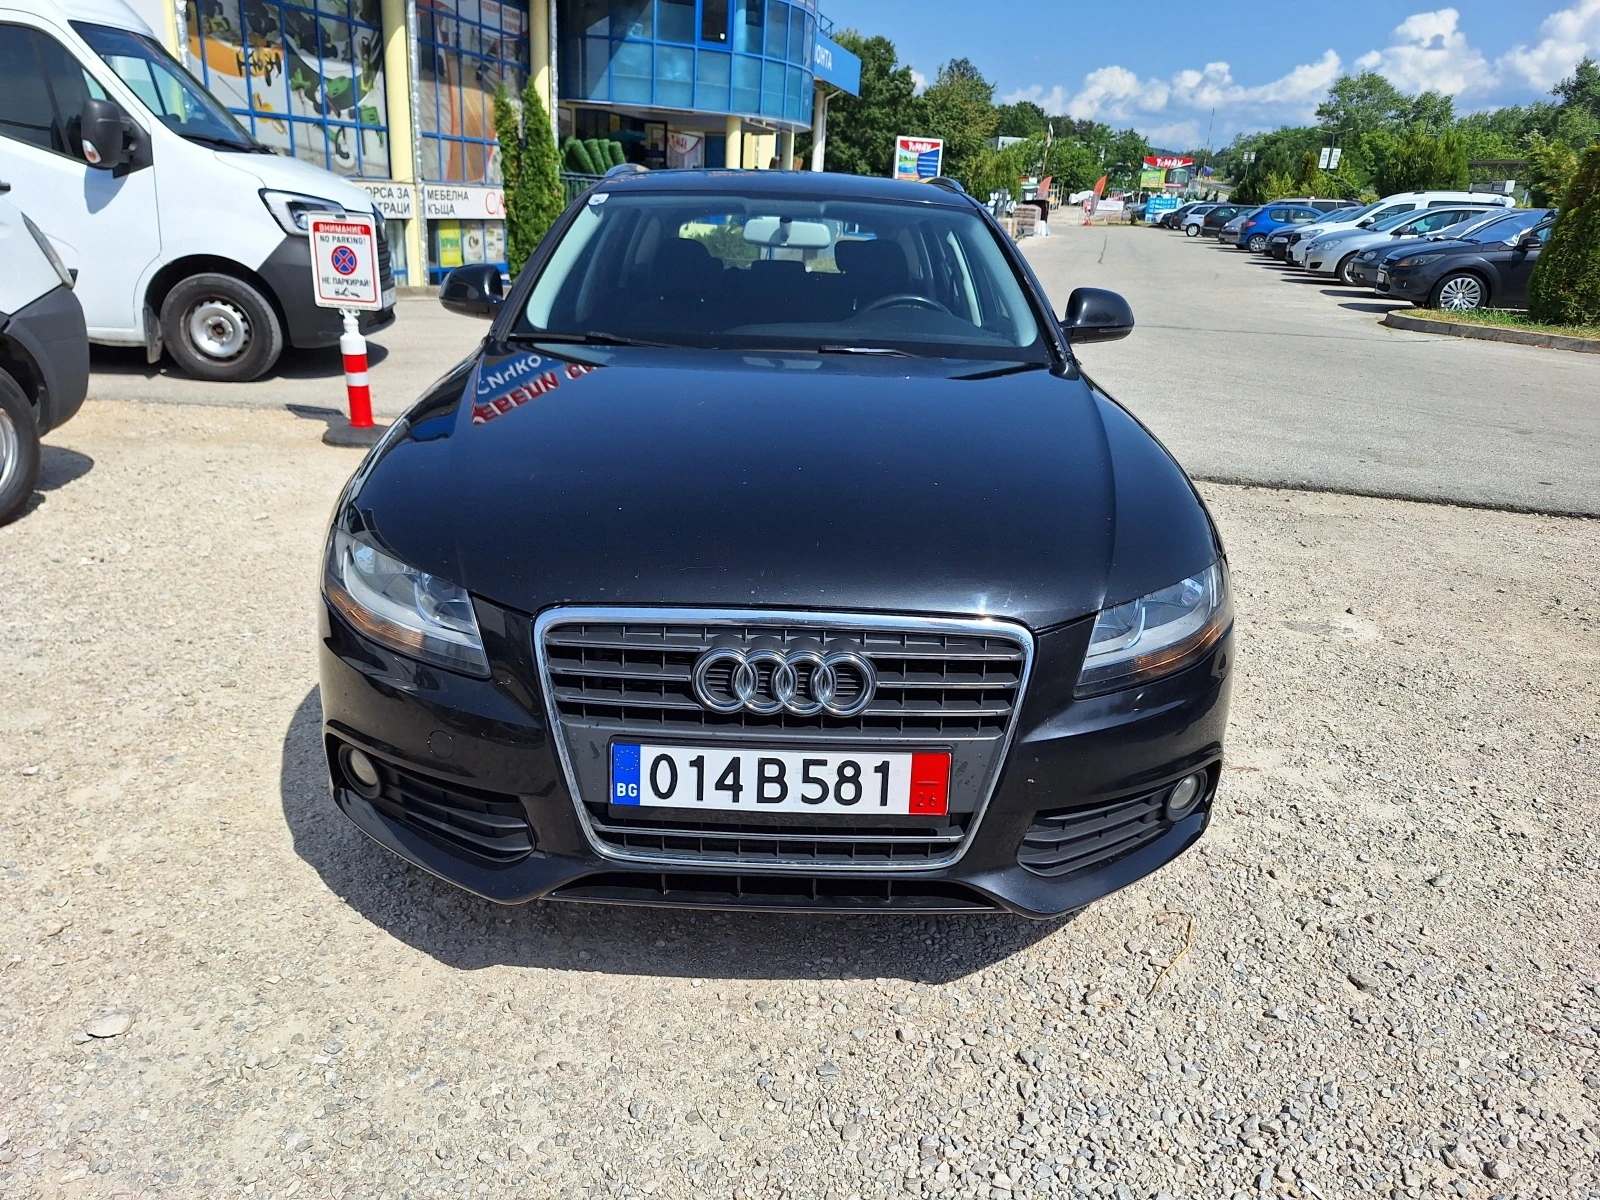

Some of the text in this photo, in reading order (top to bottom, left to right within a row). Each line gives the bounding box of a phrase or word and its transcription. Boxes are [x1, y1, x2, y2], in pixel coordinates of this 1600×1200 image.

[397, 188, 410, 199] ЗА
[427, 190, 469, 201] МЕБЕЛНА
[427, 203, 455, 216] КЪЩА
[318, 223, 366, 236] ВНИМАНИЕ!
[320, 235, 366, 245] NO PARKING!
[321, 276, 371, 287] НЕ ПАРКИРАЙ!
[650, 753, 890, 807] 014B581
[616, 782, 638, 798] BG
